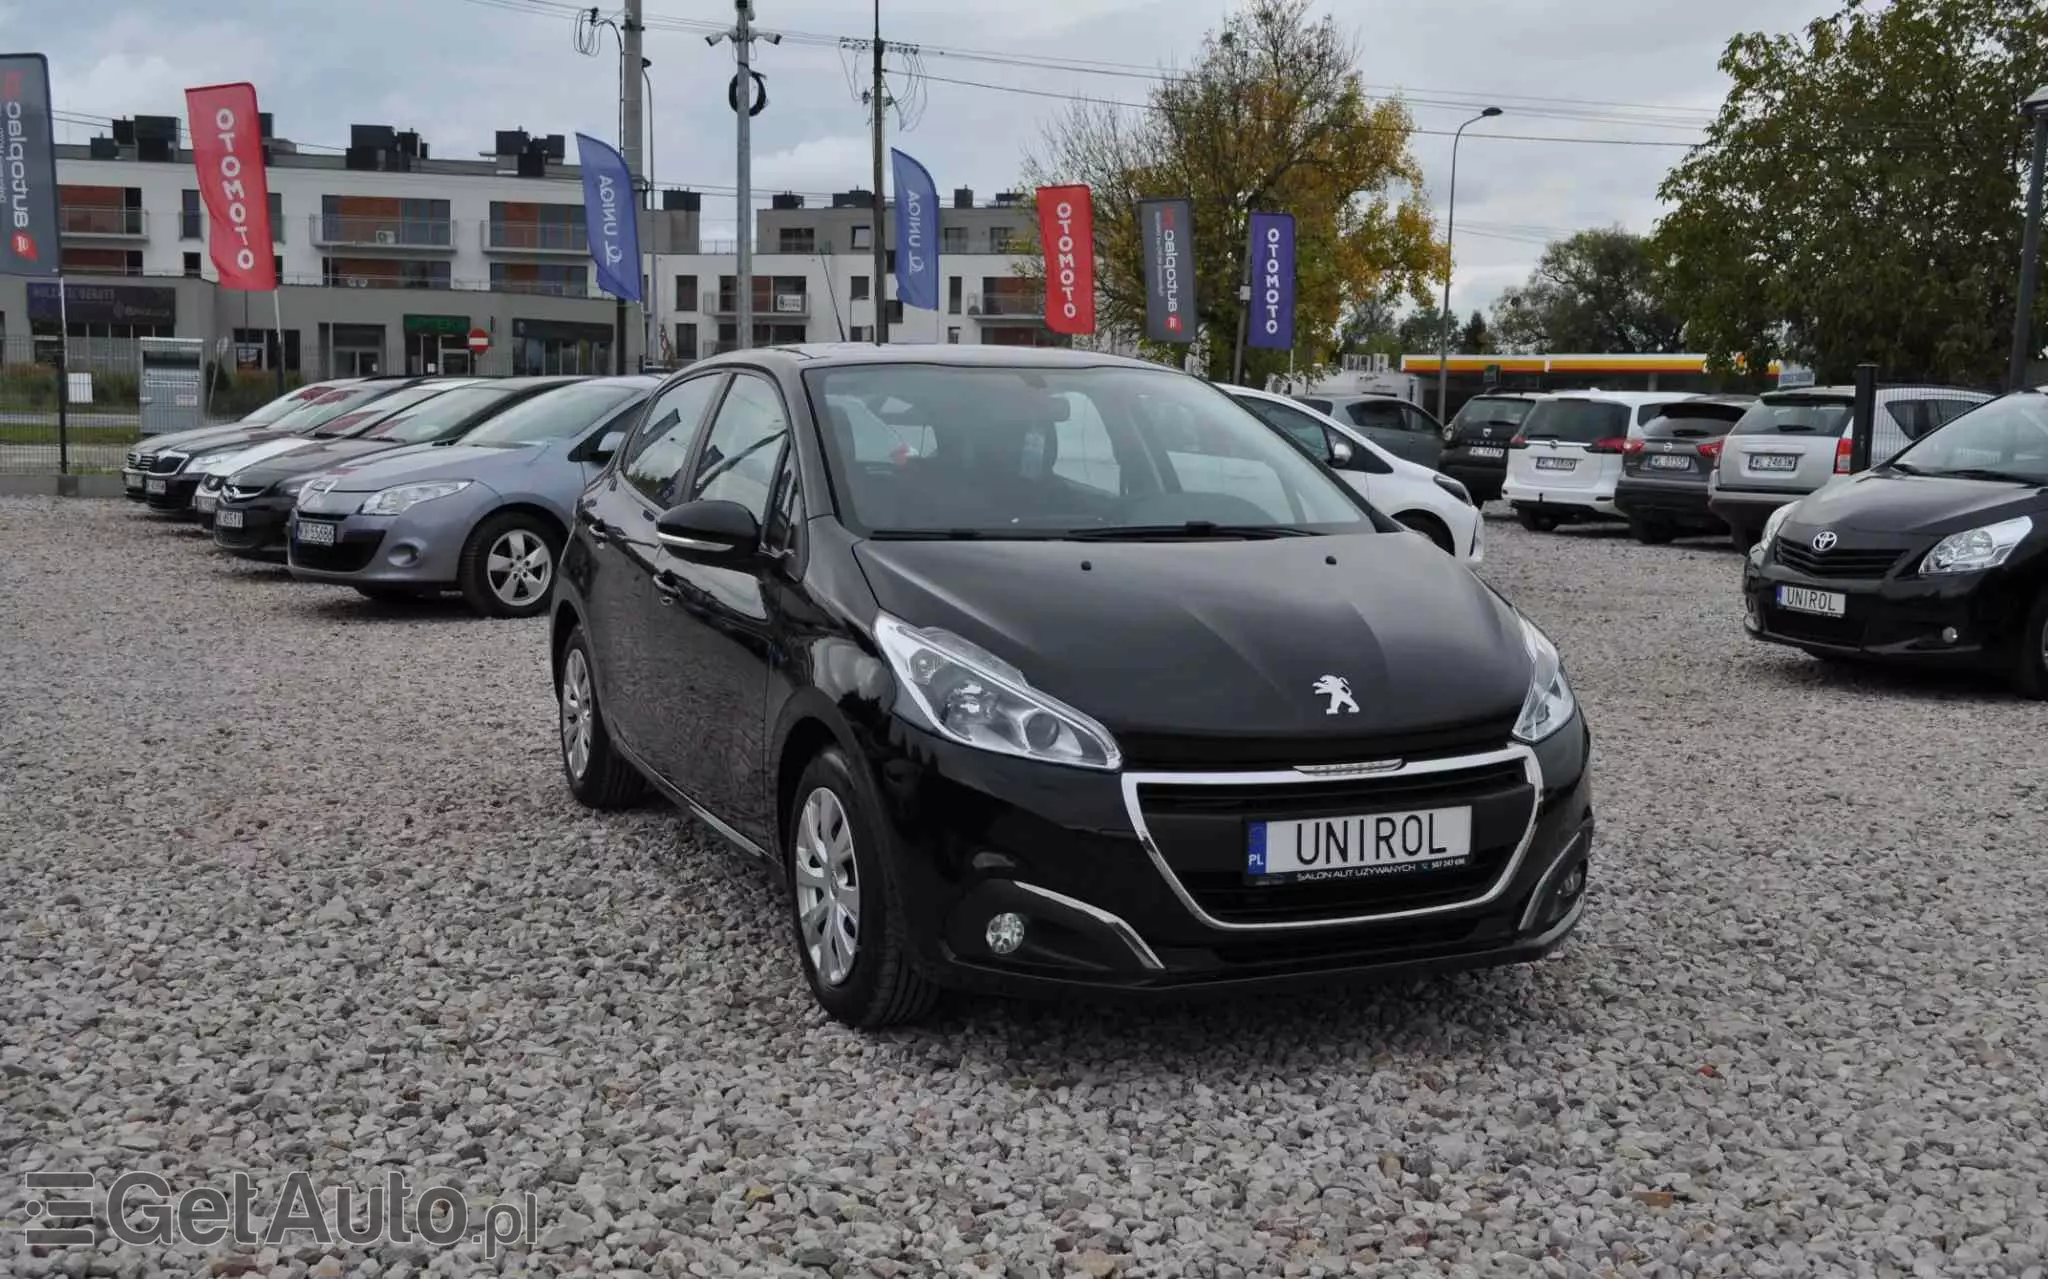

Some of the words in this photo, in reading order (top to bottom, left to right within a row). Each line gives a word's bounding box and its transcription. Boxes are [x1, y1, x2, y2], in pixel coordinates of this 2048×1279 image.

[215, 107, 255, 270] OTOMOTO
[1056, 201, 1077, 320] OTOMOTO
[1264, 227, 1281, 335] OTOMOTO
[1787, 587, 1837, 611] UNIROL
[1249, 853, 1264, 866] PL
[1296, 813, 1447, 865] UNIROL
[1296, 870, 1333, 882] SALON
[1333, 868, 1354, 879] AUT
